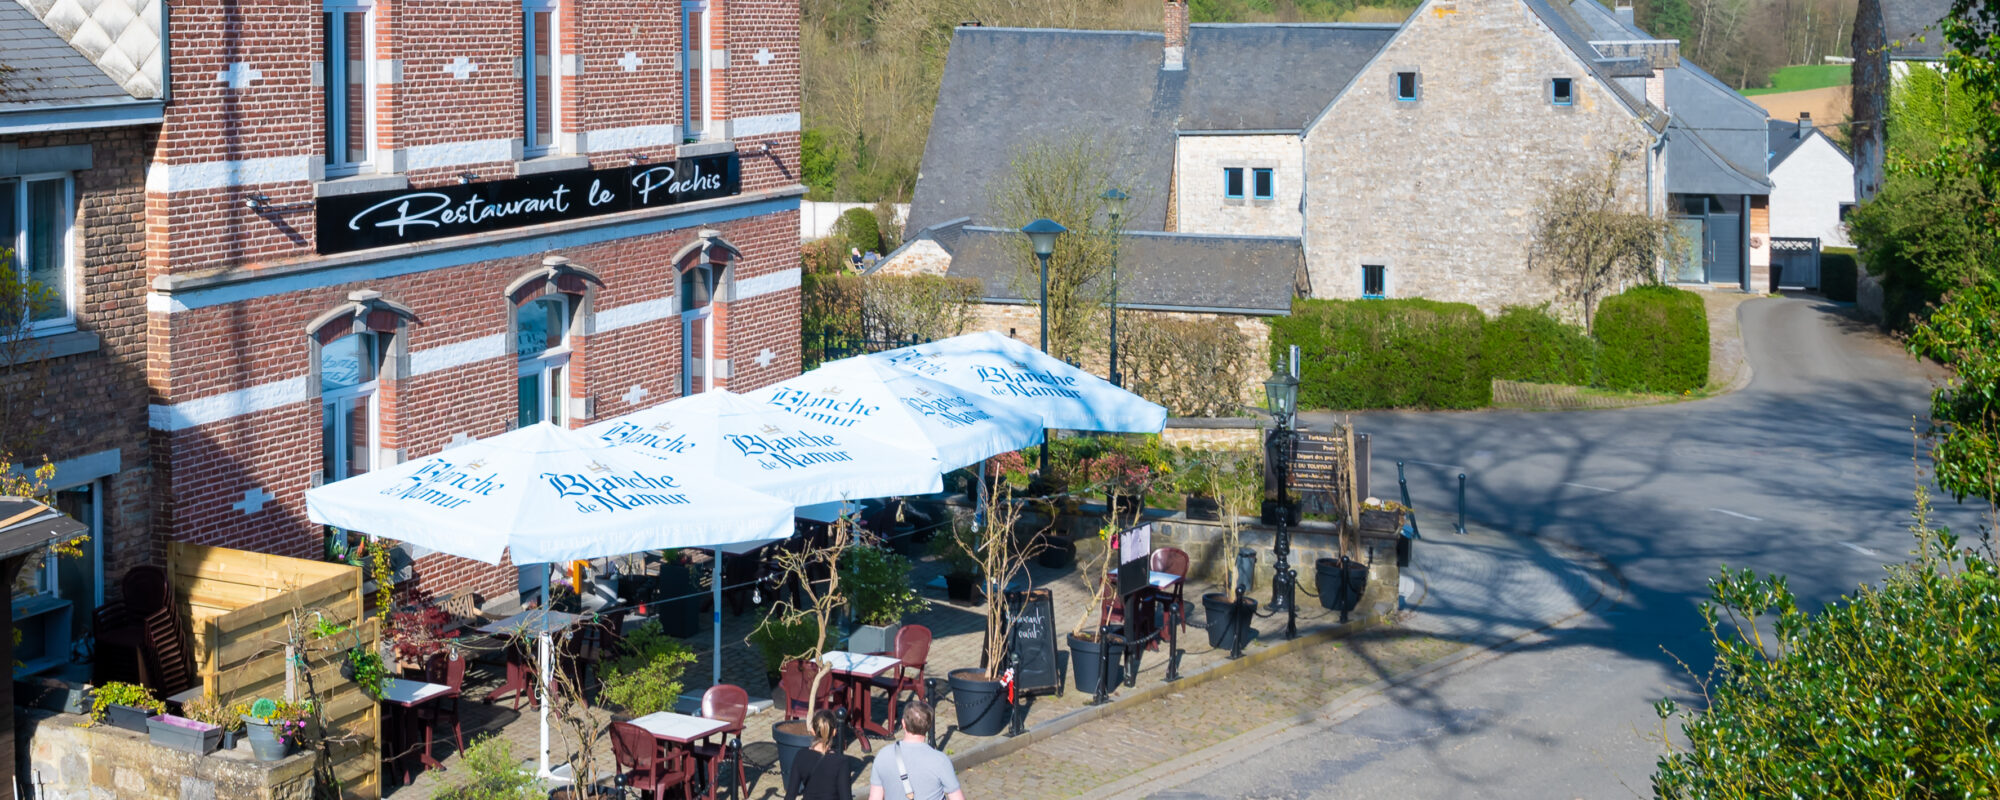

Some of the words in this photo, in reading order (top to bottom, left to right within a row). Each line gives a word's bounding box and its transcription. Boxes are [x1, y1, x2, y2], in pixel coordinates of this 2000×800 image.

[348, 188, 570, 237] Restaurant
[588, 178, 615, 207] le
[631, 165, 721, 205] Pachis
[969, 364, 1081, 387] Blanche
[766, 386, 881, 416] Blanche
[990, 385, 1007, 396] de
[1006, 381, 1082, 399] Namur
[899, 393, 974, 416] Blanche
[599, 421, 697, 454] Blanche
[723, 430, 842, 457] Blanche
[1308, 434, 1328, 442] Parking
[757, 458, 781, 470] de
[768, 449, 854, 470] Namur
[404, 458, 505, 496] Blanche
[539, 470, 682, 499] Blanche
[395, 482, 472, 509] Namur
[574, 500, 601, 514] de
[590, 489, 691, 513] Namur
